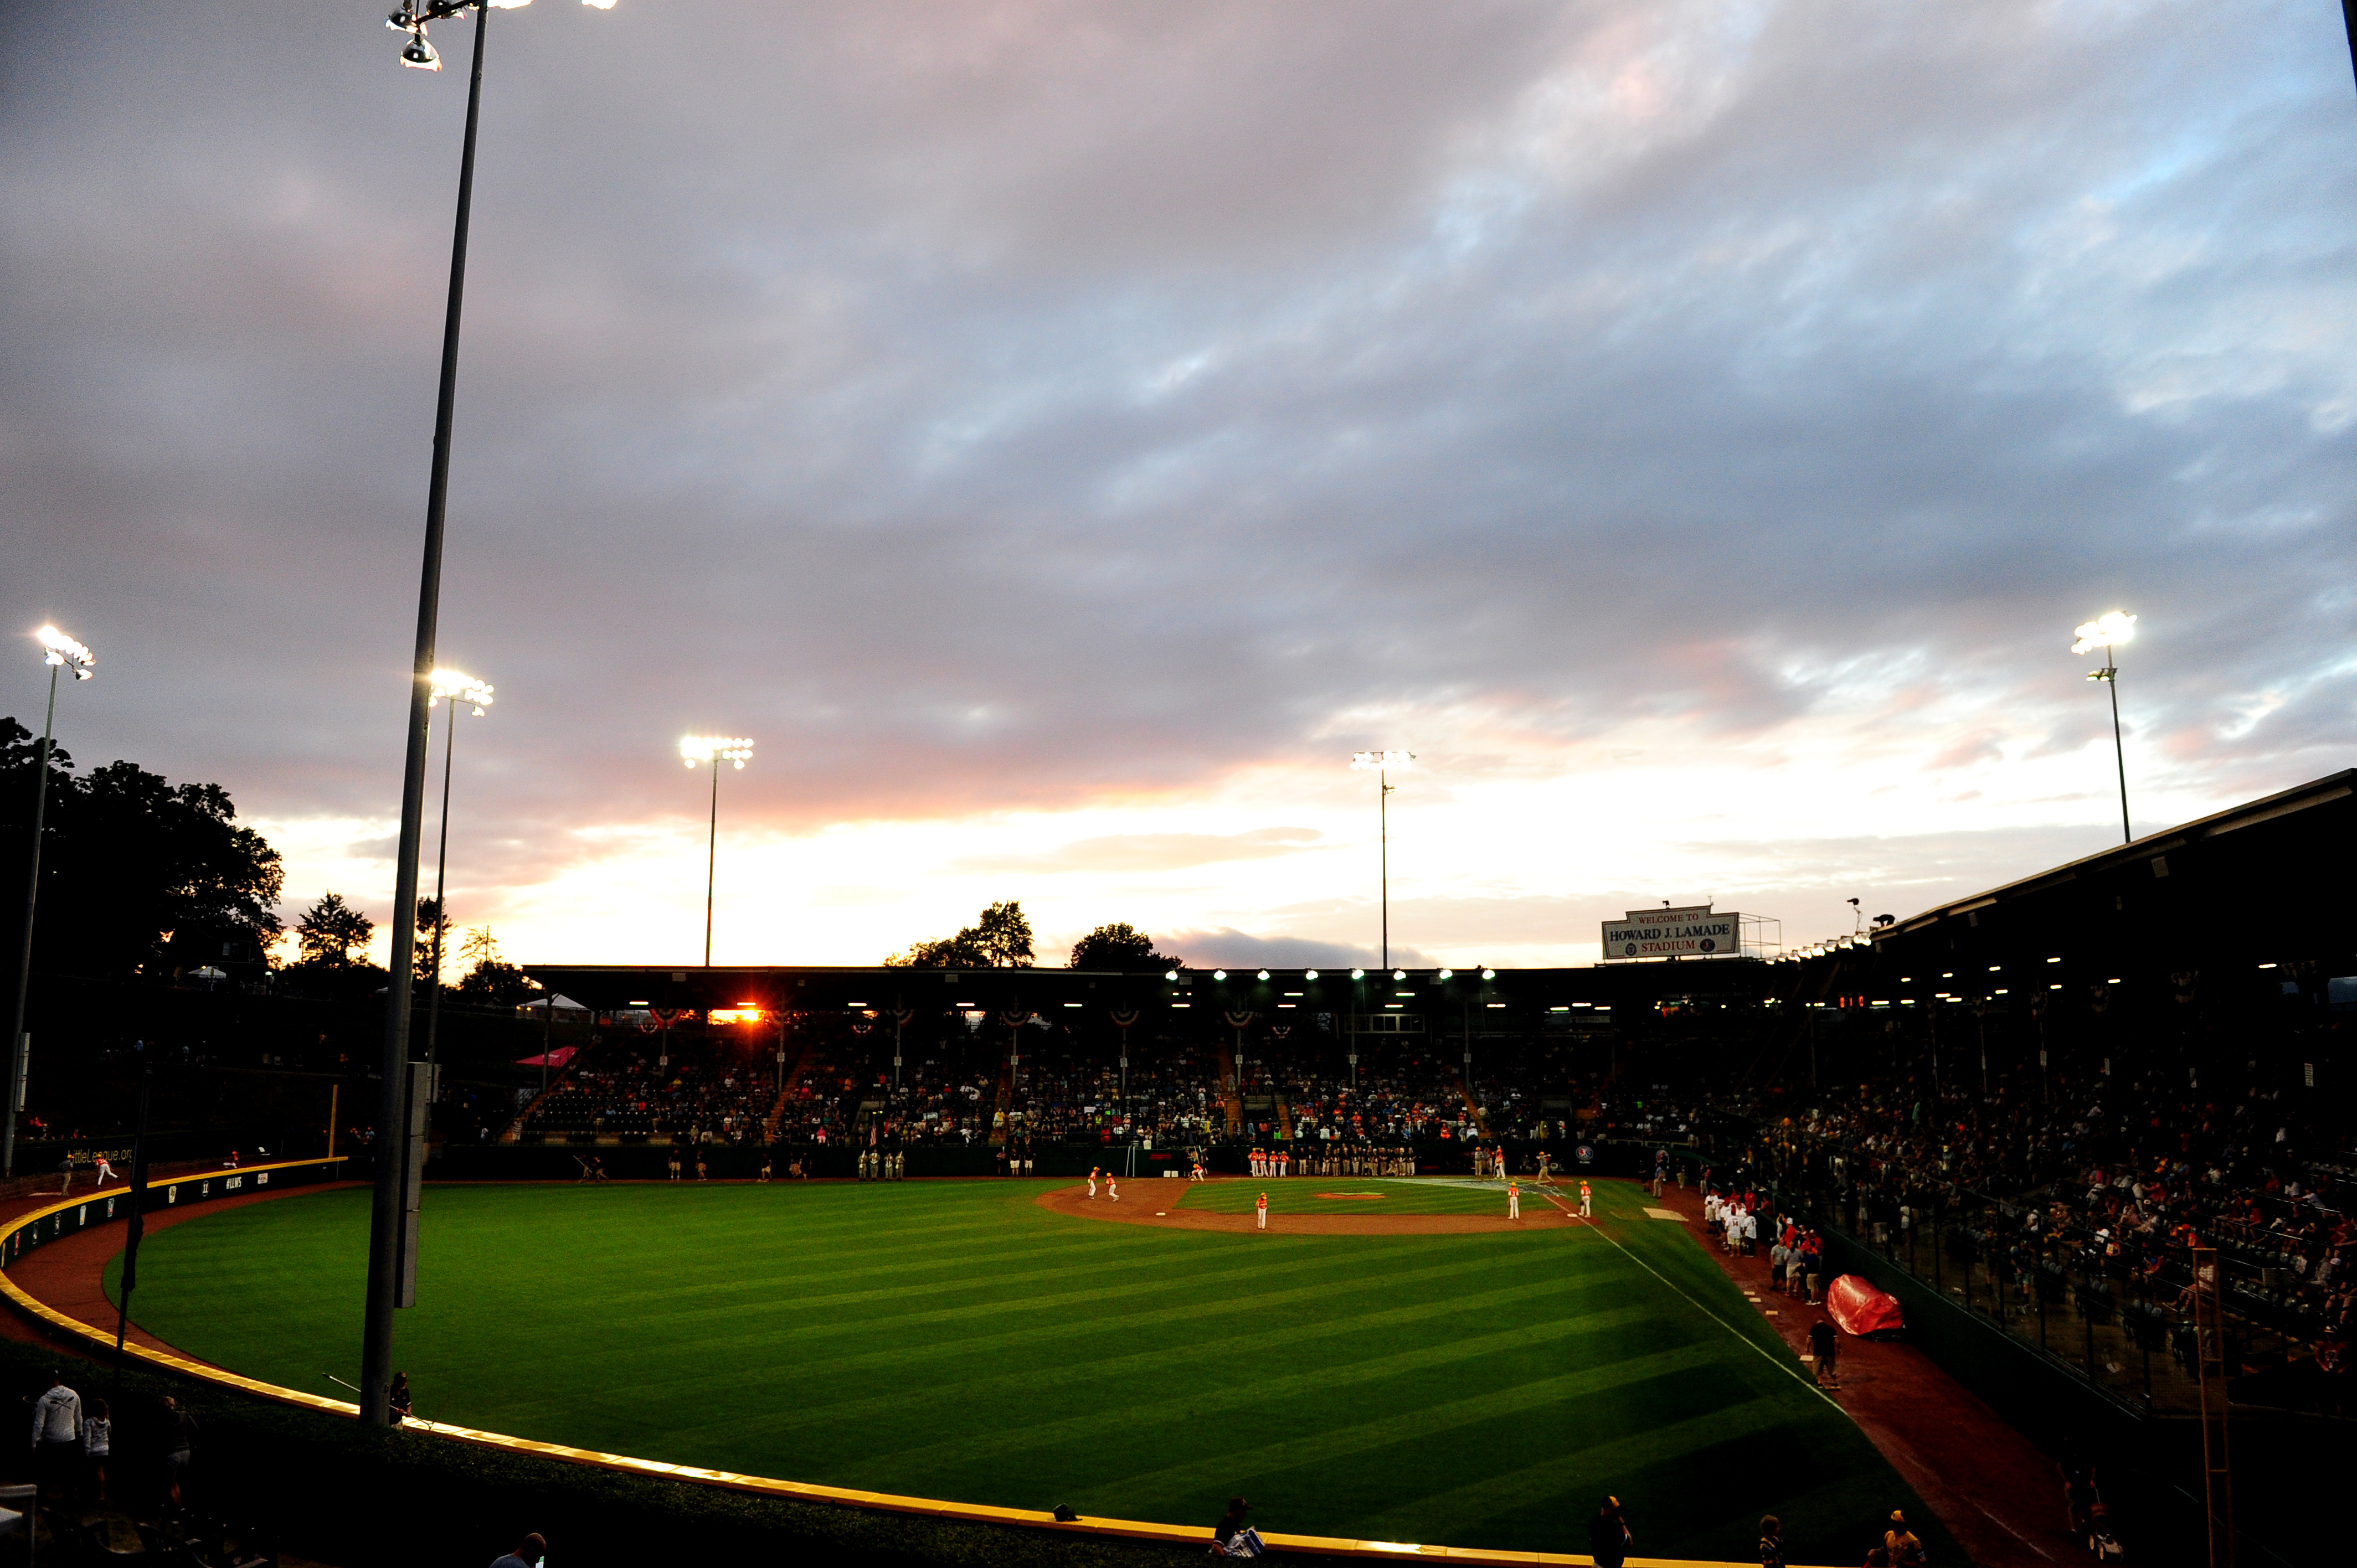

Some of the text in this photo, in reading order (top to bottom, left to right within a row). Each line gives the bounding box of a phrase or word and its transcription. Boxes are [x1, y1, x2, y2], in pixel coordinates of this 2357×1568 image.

[1639, 915, 1683, 924] WELCOME
[1610, 924, 1730, 941] HOWARD J. LAMADE
[1641, 940, 1696, 952] STADIUM
